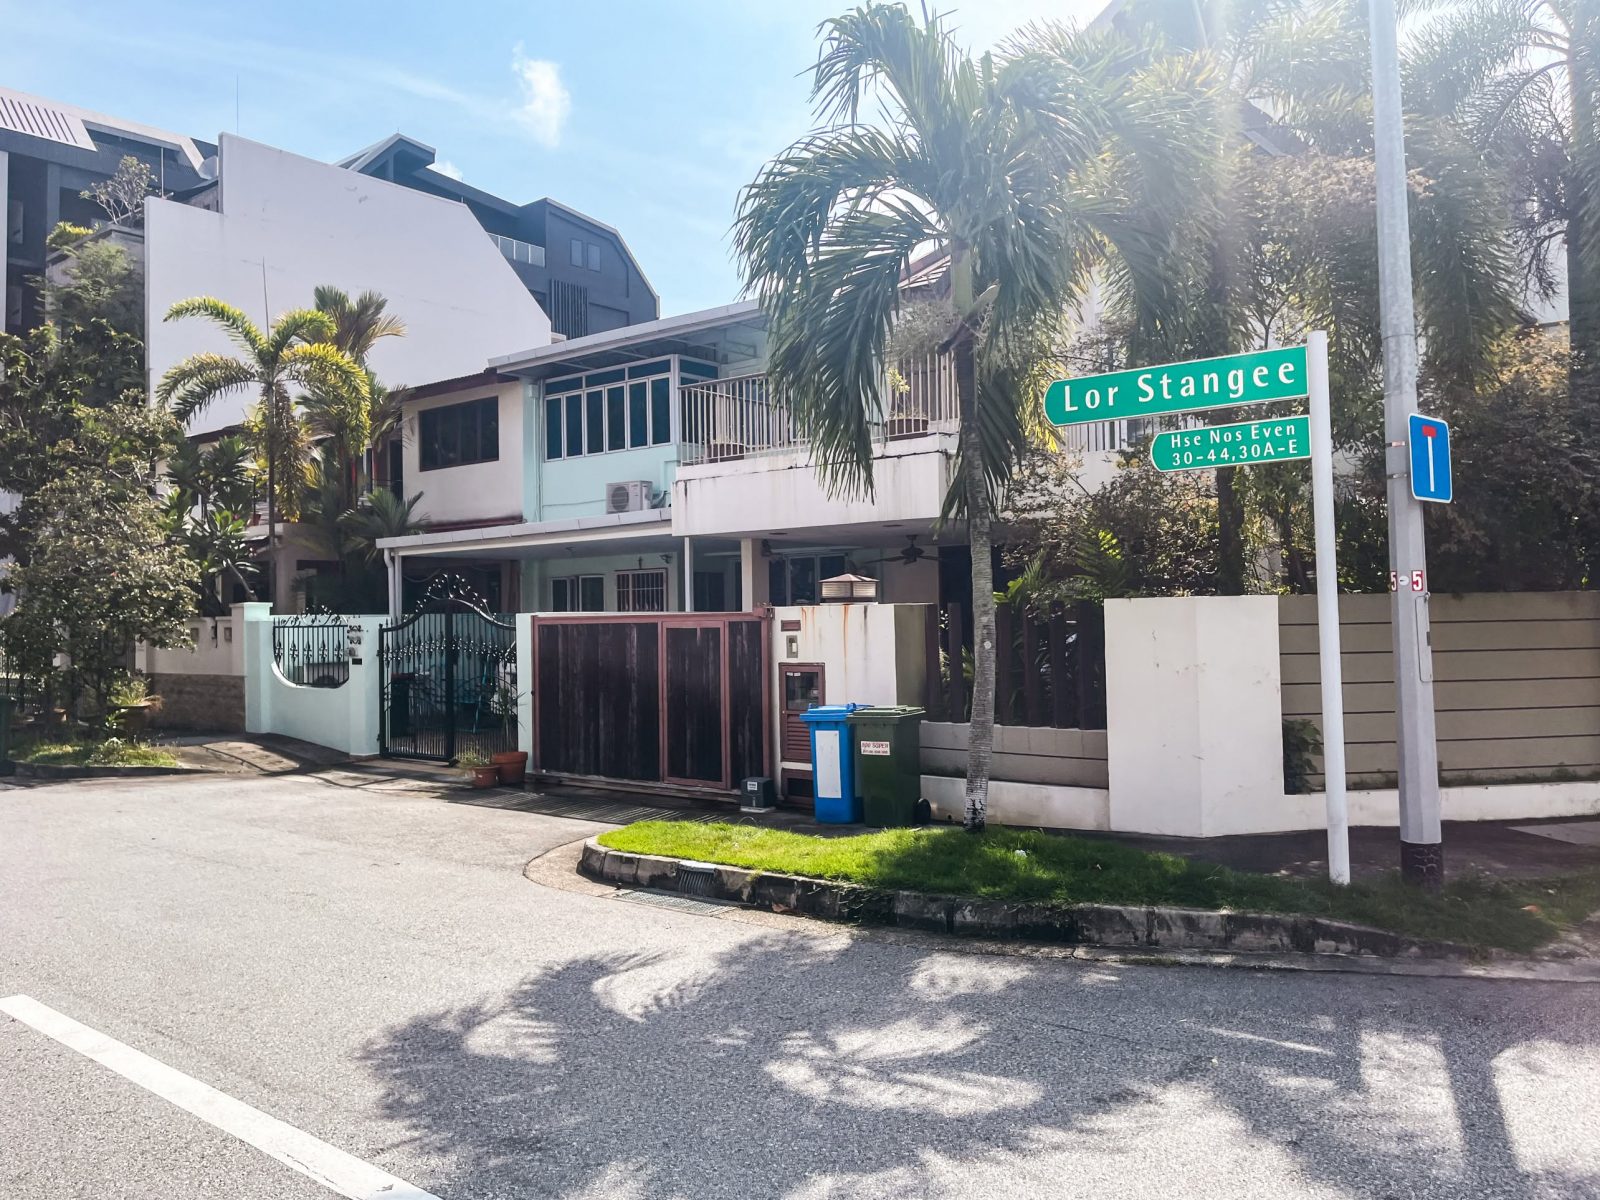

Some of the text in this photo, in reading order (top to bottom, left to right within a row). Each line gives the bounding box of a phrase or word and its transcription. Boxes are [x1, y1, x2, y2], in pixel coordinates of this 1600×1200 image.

[1063, 362, 1295, 412] Lor Stangee
[1171, 424, 1296, 448] Hse Nos Even
[1173, 440, 1298, 466] 30-44,30A-E
[1390, 571, 1397, 591] 5
[1412, 571, 1422, 591] 5
